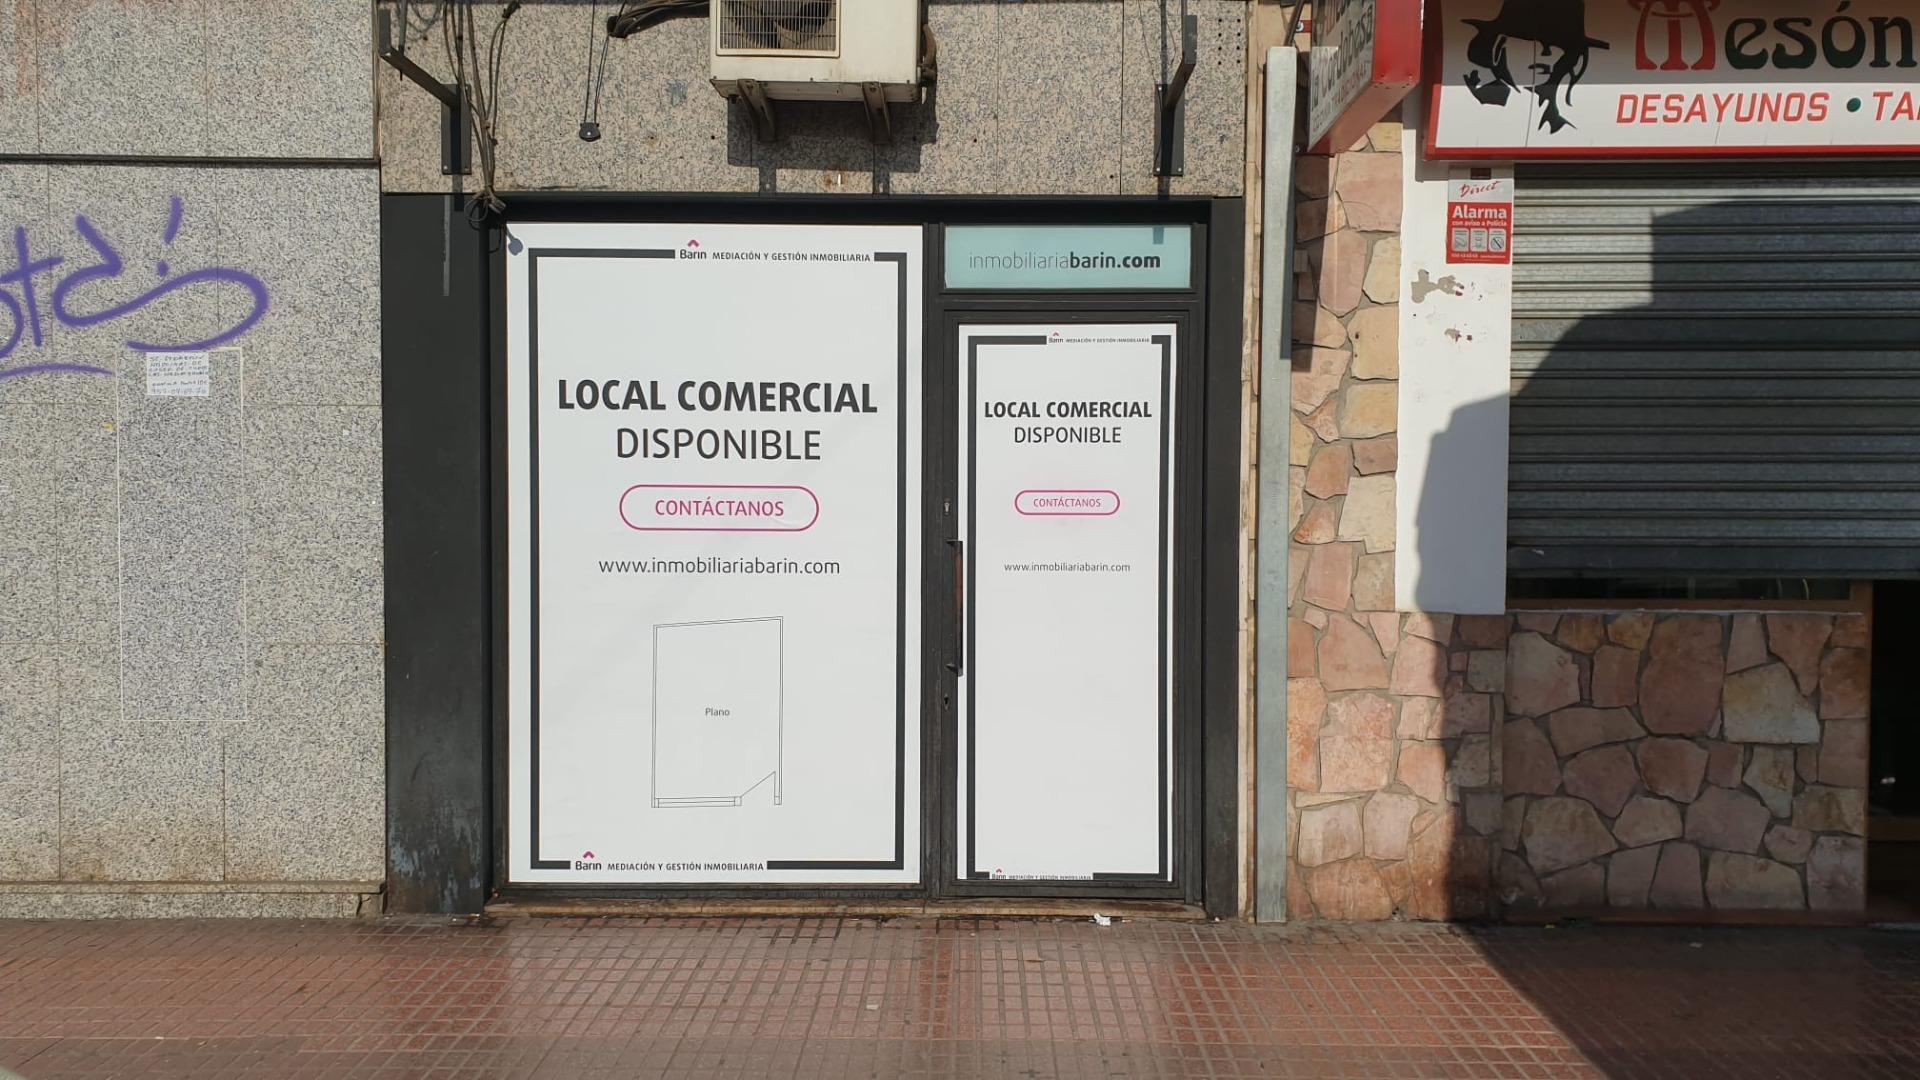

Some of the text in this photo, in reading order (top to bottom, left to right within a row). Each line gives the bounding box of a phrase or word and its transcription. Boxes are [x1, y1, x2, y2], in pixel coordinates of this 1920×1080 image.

[1616, 91, 1830, 124] DESAYUNOS
[1452, 204, 1507, 219] Alarma
[680, 248, 871, 263] Barin MEDIACIÓN Y GESTIÓN INMOBILIARIA
[969, 251, 1161, 269] inmobiliariabarin.com
[558, 379, 878, 414] LOCAL COMERCIAL
[985, 401, 1153, 418] LOCAL COMERCIAL
[616, 427, 821, 460] DISPONIBLE
[1014, 426, 1121, 444] DISPONIBLE
[654, 495, 785, 517] CONTÁCTANOS
[1033, 495, 1102, 508] CONTÁCTANOS
[598, 556, 841, 575] www.inmobiliariabarin.com
[1003, 561, 1131, 572] www.inmobiliariabarin.com
[705, 706, 731, 717] Plano
[575, 856, 764, 872] Barin MEDIACIÓN Y GESTIÓN INMOBILIARIA
